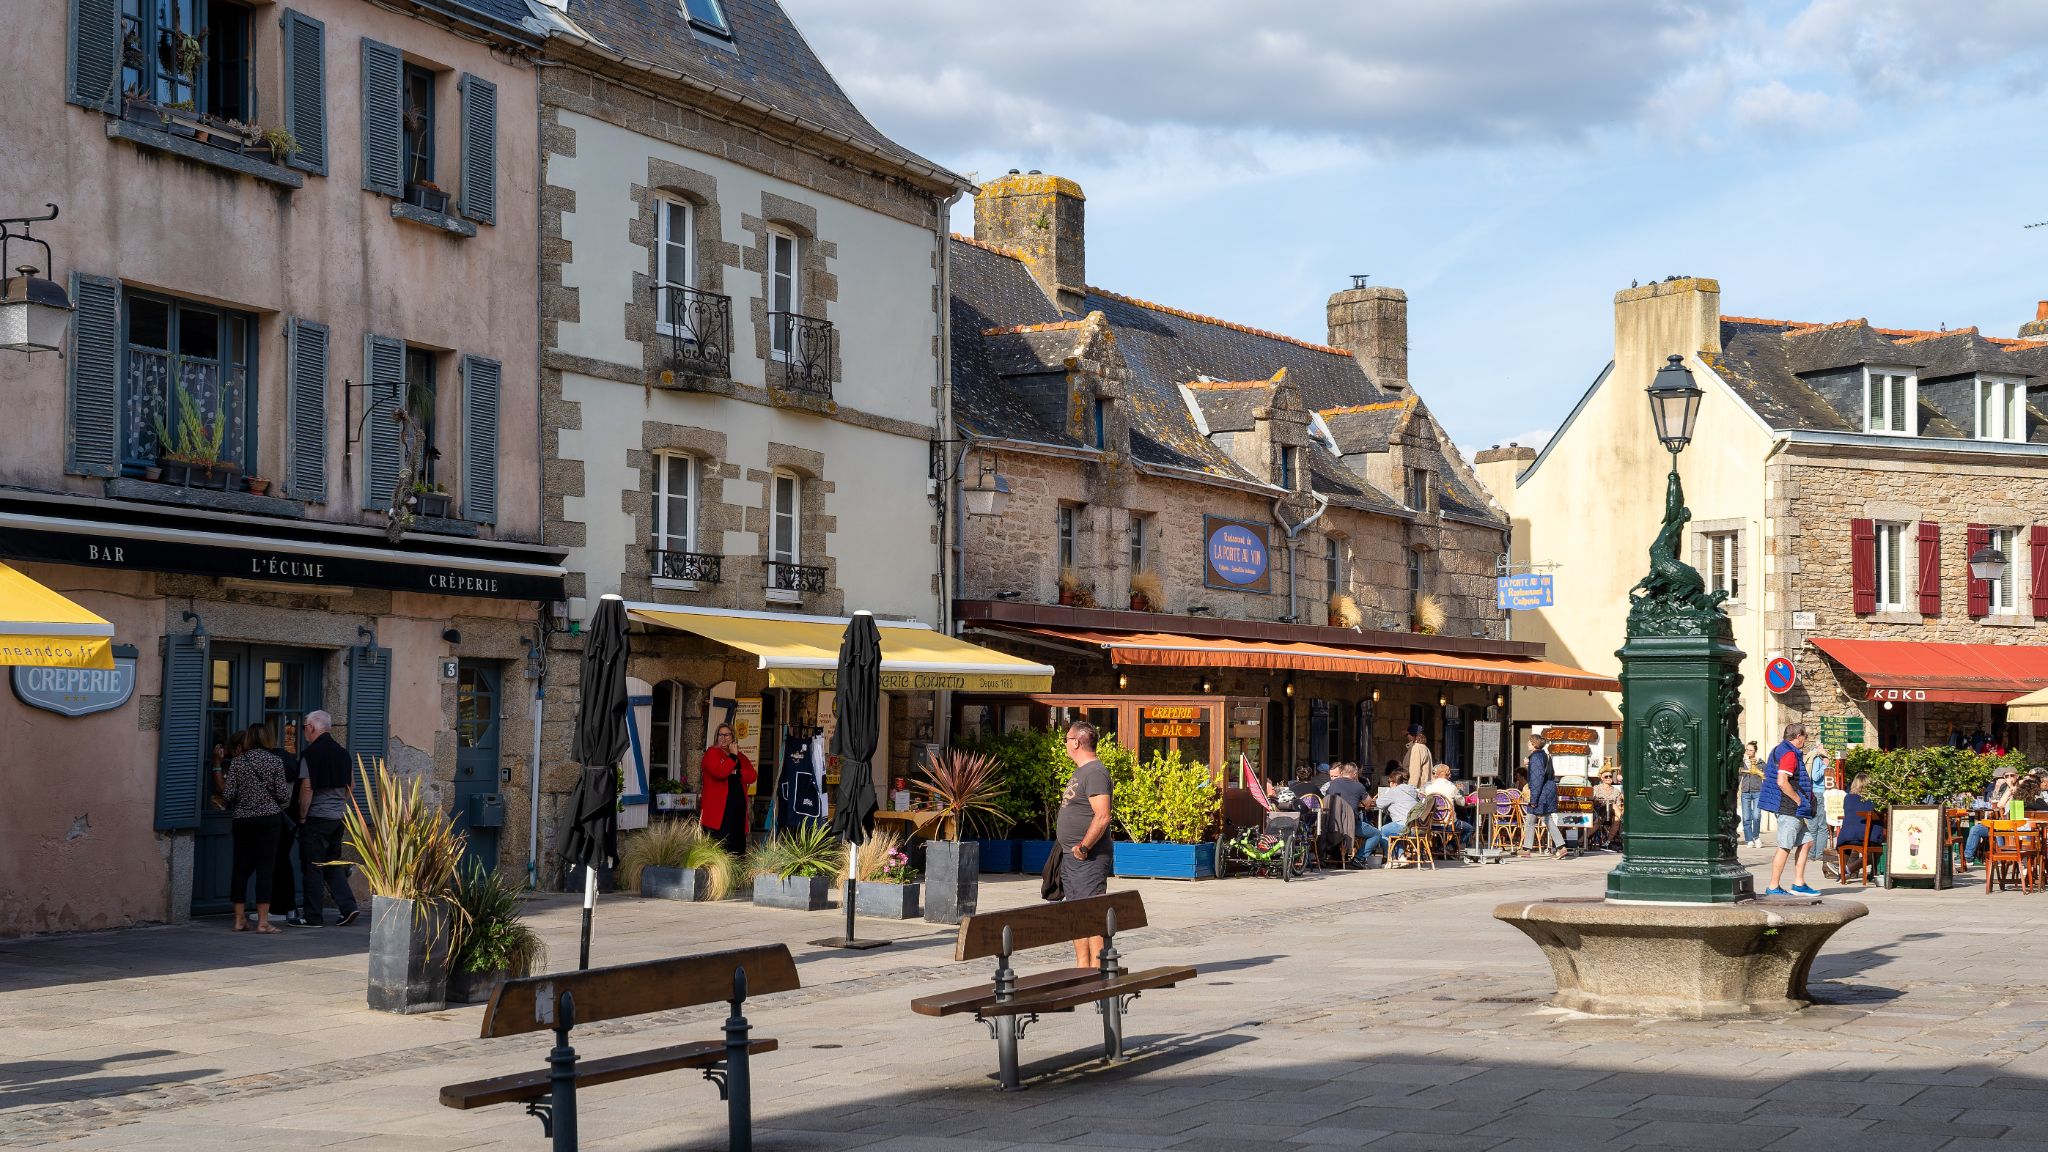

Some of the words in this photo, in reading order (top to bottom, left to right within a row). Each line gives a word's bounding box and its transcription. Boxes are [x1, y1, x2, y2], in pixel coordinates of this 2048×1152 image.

[88, 544, 125, 563] BAR
[1214, 544, 1222, 559] LA
[1223, 546, 1241, 562] PORTE
[1242, 549, 1249, 562] AU
[1250, 550, 1261, 565] VIN
[251, 556, 325, 579] L'ÉCUME
[428, 572, 499, 592] CRÊPERIE
[1500, 579, 1508, 588] LA
[1508, 587, 1543, 597] Restaurant
[0, 645, 93, 657] neandco.fr
[447, 663, 456, 677] 3
[1873, 689, 1926, 700] KOKO
[1151, 706, 1194, 719] CREPERIE
[1161, 724, 1183, 737] BAR
